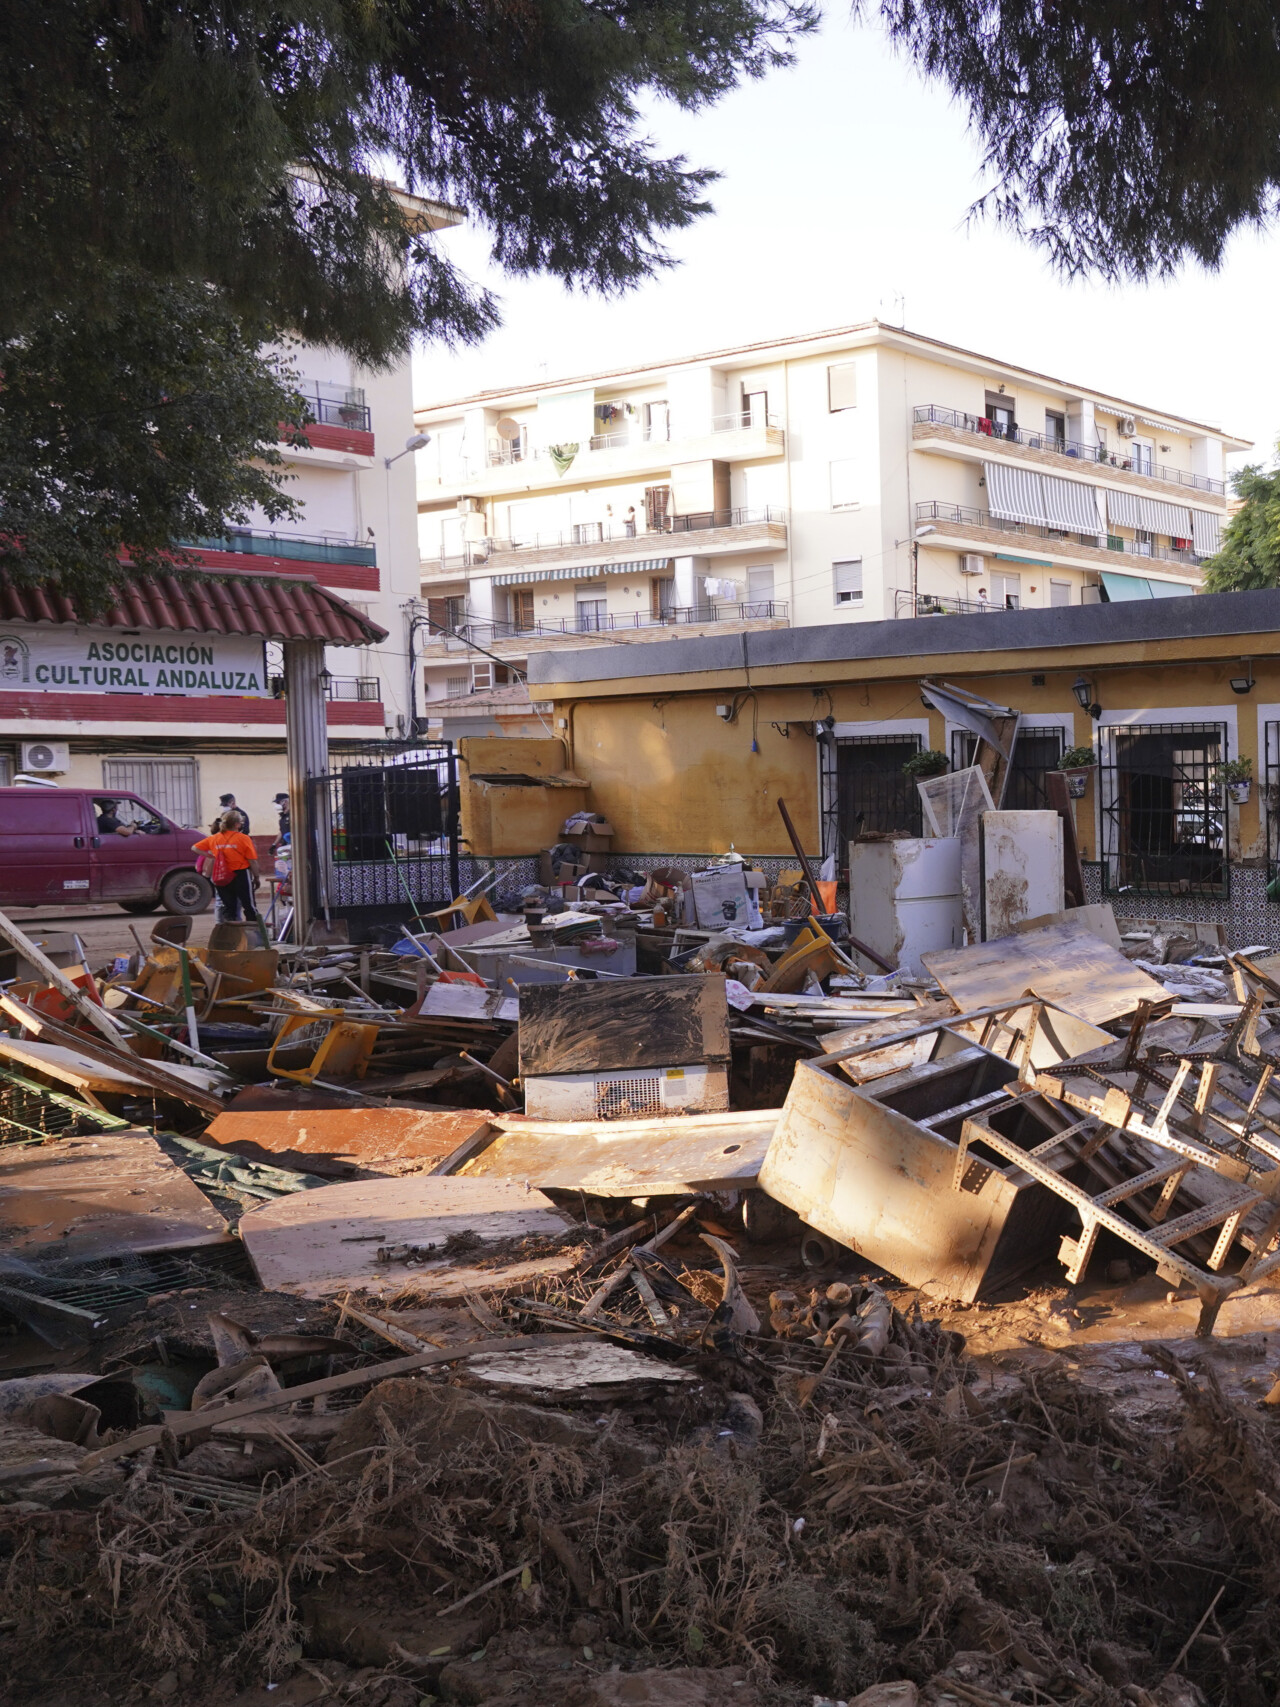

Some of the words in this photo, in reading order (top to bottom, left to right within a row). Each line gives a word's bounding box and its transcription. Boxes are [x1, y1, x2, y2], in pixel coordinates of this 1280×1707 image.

[87, 642, 214, 666] ASOCIACIÓN
[35, 665, 149, 687] CULTURAL
[156, 669, 260, 690] ANDALUZA
